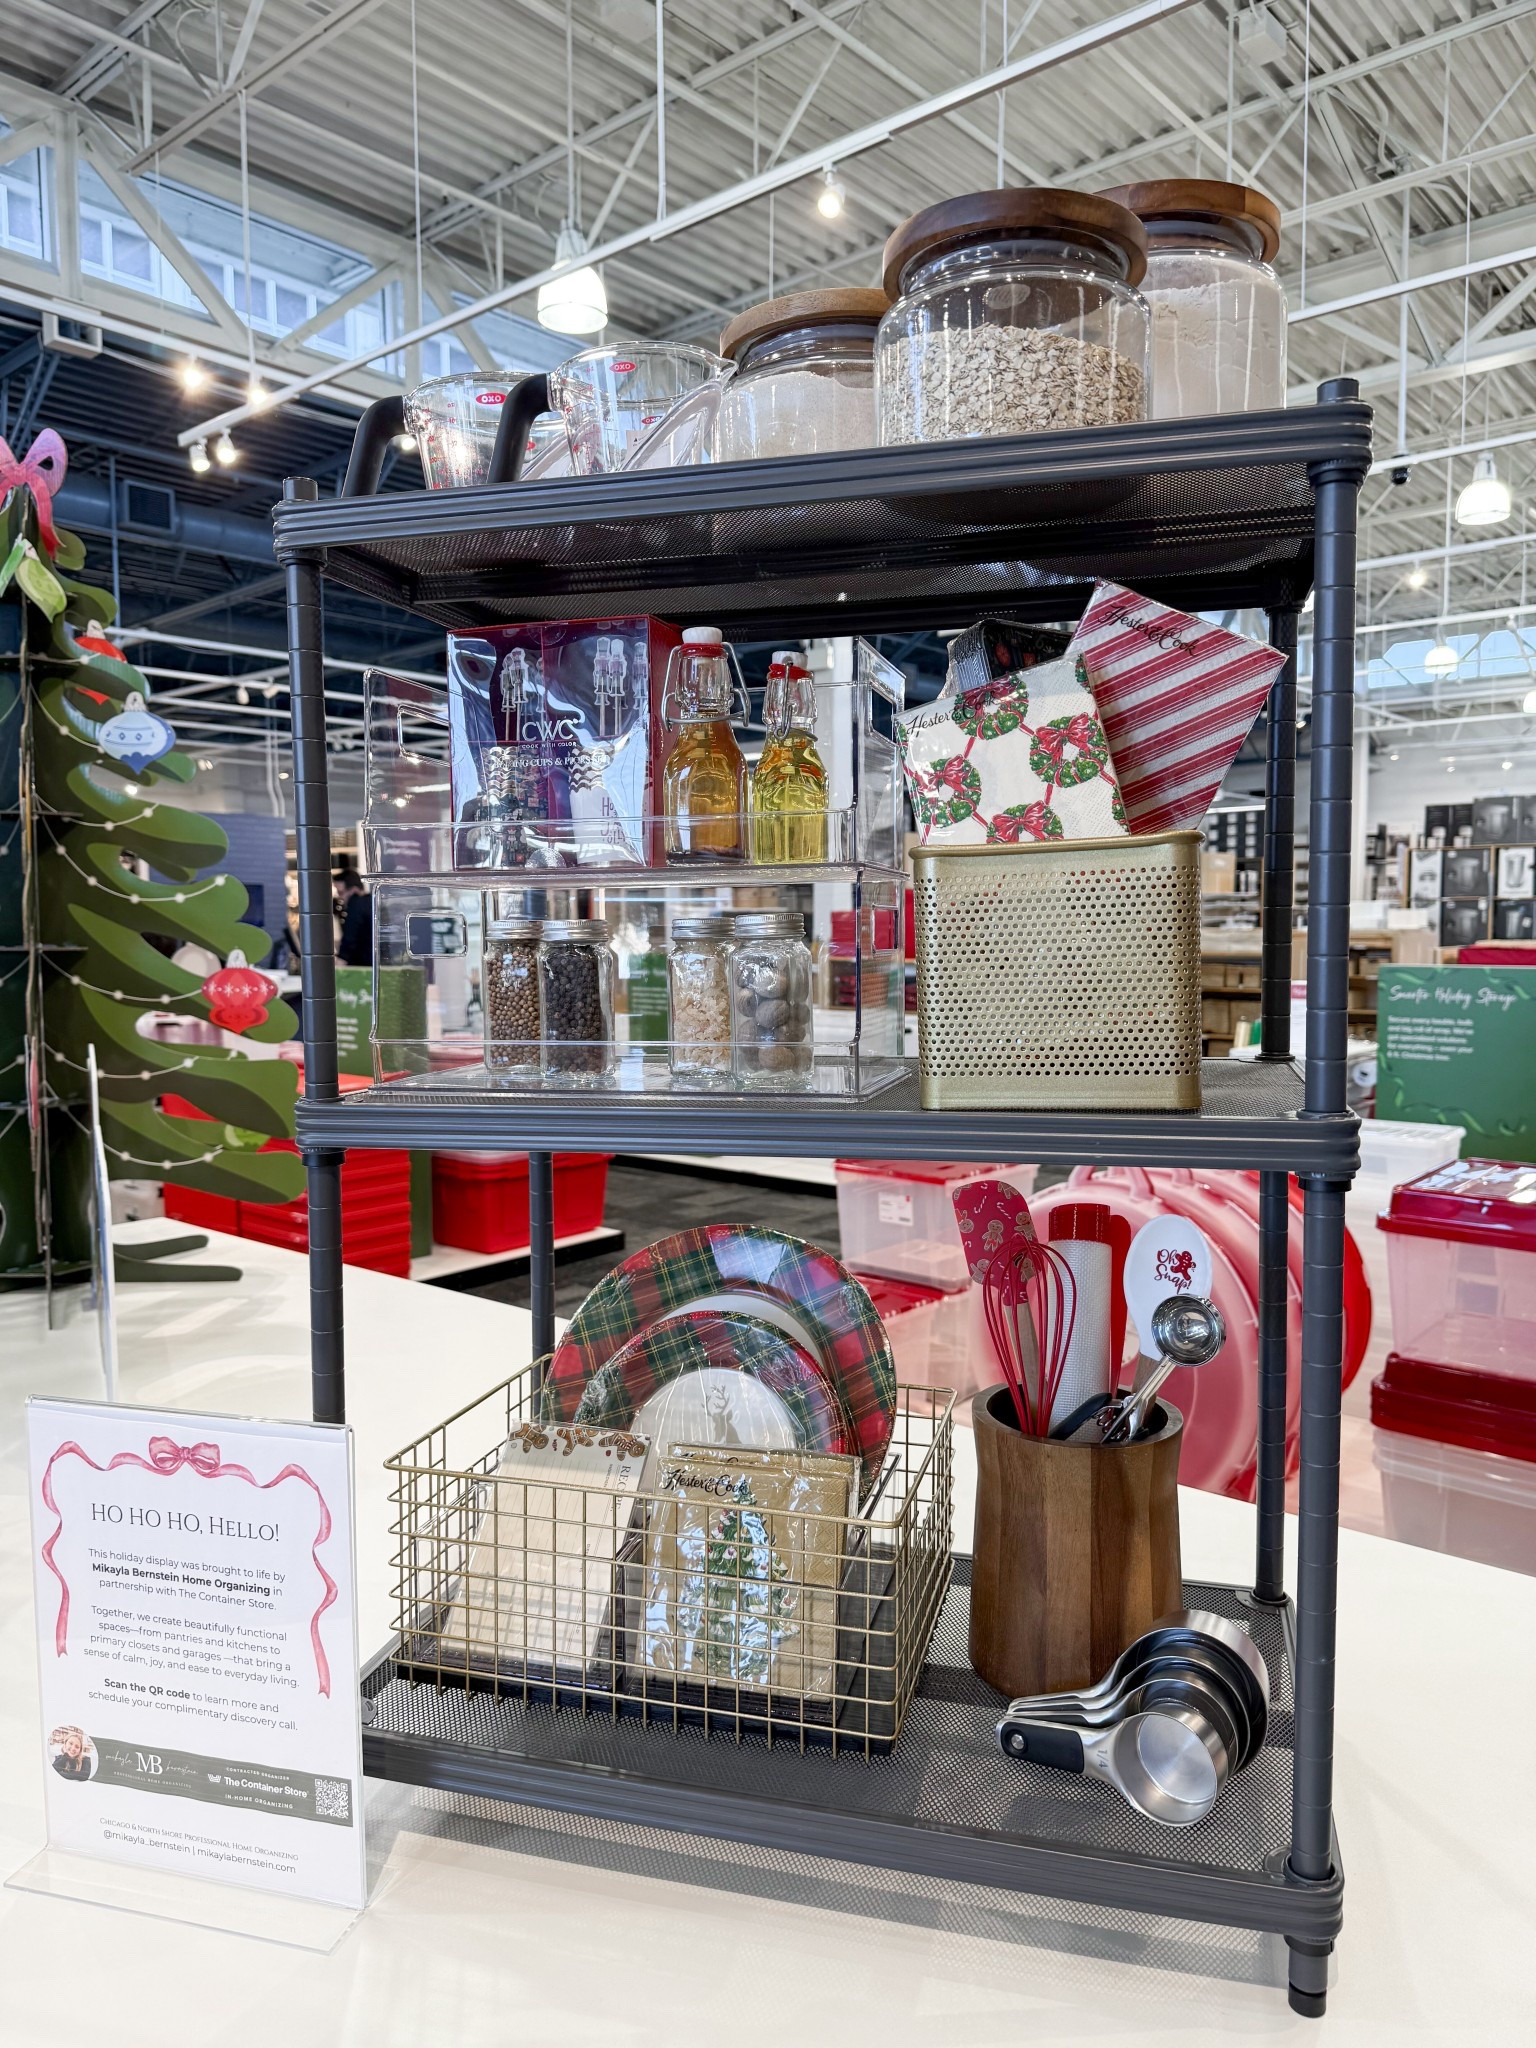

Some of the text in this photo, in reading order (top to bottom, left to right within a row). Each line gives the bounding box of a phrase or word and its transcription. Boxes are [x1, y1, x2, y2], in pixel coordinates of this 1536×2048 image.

[522, 719, 578, 742] CWC
[530, 758, 553, 766] CUPS
[1157, 1249, 1178, 1265] Oh
[1154, 1264, 1192, 1295] Snap!
[92, 1503, 123, 1523] HO
[129, 1507, 161, 1527] HO
[168, 1512, 203, 1534] HO,
[88, 1548, 285, 1583] This holiday display was brought to life by
[92, 1563, 283, 1596] Mikayla Bernstein Home Organizing in
[99, 1579, 277, 1610] partnership with The Container Store.
[91, 1605, 287, 1641] Together, we create beautifully functional
[90, 1634, 126, 1648] primary
[128, 1640, 160, 1652] closets
[162, 1645, 180, 1655] and
[182, 1648, 222, 1662] garages
[256, 1658, 283, 1672] bring
[285, 1663, 291, 1671] a
[164, 1631, 203, 1645] pantries
[205, 1637, 224, 1647] and
[226, 1640, 268, 1654] kitchens
[270, 1646, 280, 1655] to
[84, 1648, 300, 1688] sense of calm, joy, and ease to everyday living.
[88, 1690, 298, 1731] schedule your complimentary discovery call.
[104, 1678, 279, 1713] Scan the QR code to learn more and
[1096, 1750, 1109, 1768] 1/4
[224, 1776, 239, 1787] The
[241, 1779, 283, 1794] Container
[225, 1794, 294, 1810] IN-HOME ORGANIZING
[100, 1817, 131, 1829] CHICAGO
[137, 1824, 161, 1835] NORTH
[161, 1829, 183, 1839] SHORE
[184, 1833, 231, 1848] PROFESSIONAL
[232, 1842, 253, 1852] HOME
[254, 1846, 299, 1861] ORGANIZING
[103, 1829, 190, 1854] @mikayla_bernstein
[197, 1848, 296, 1874] mikaylabernstein.com
